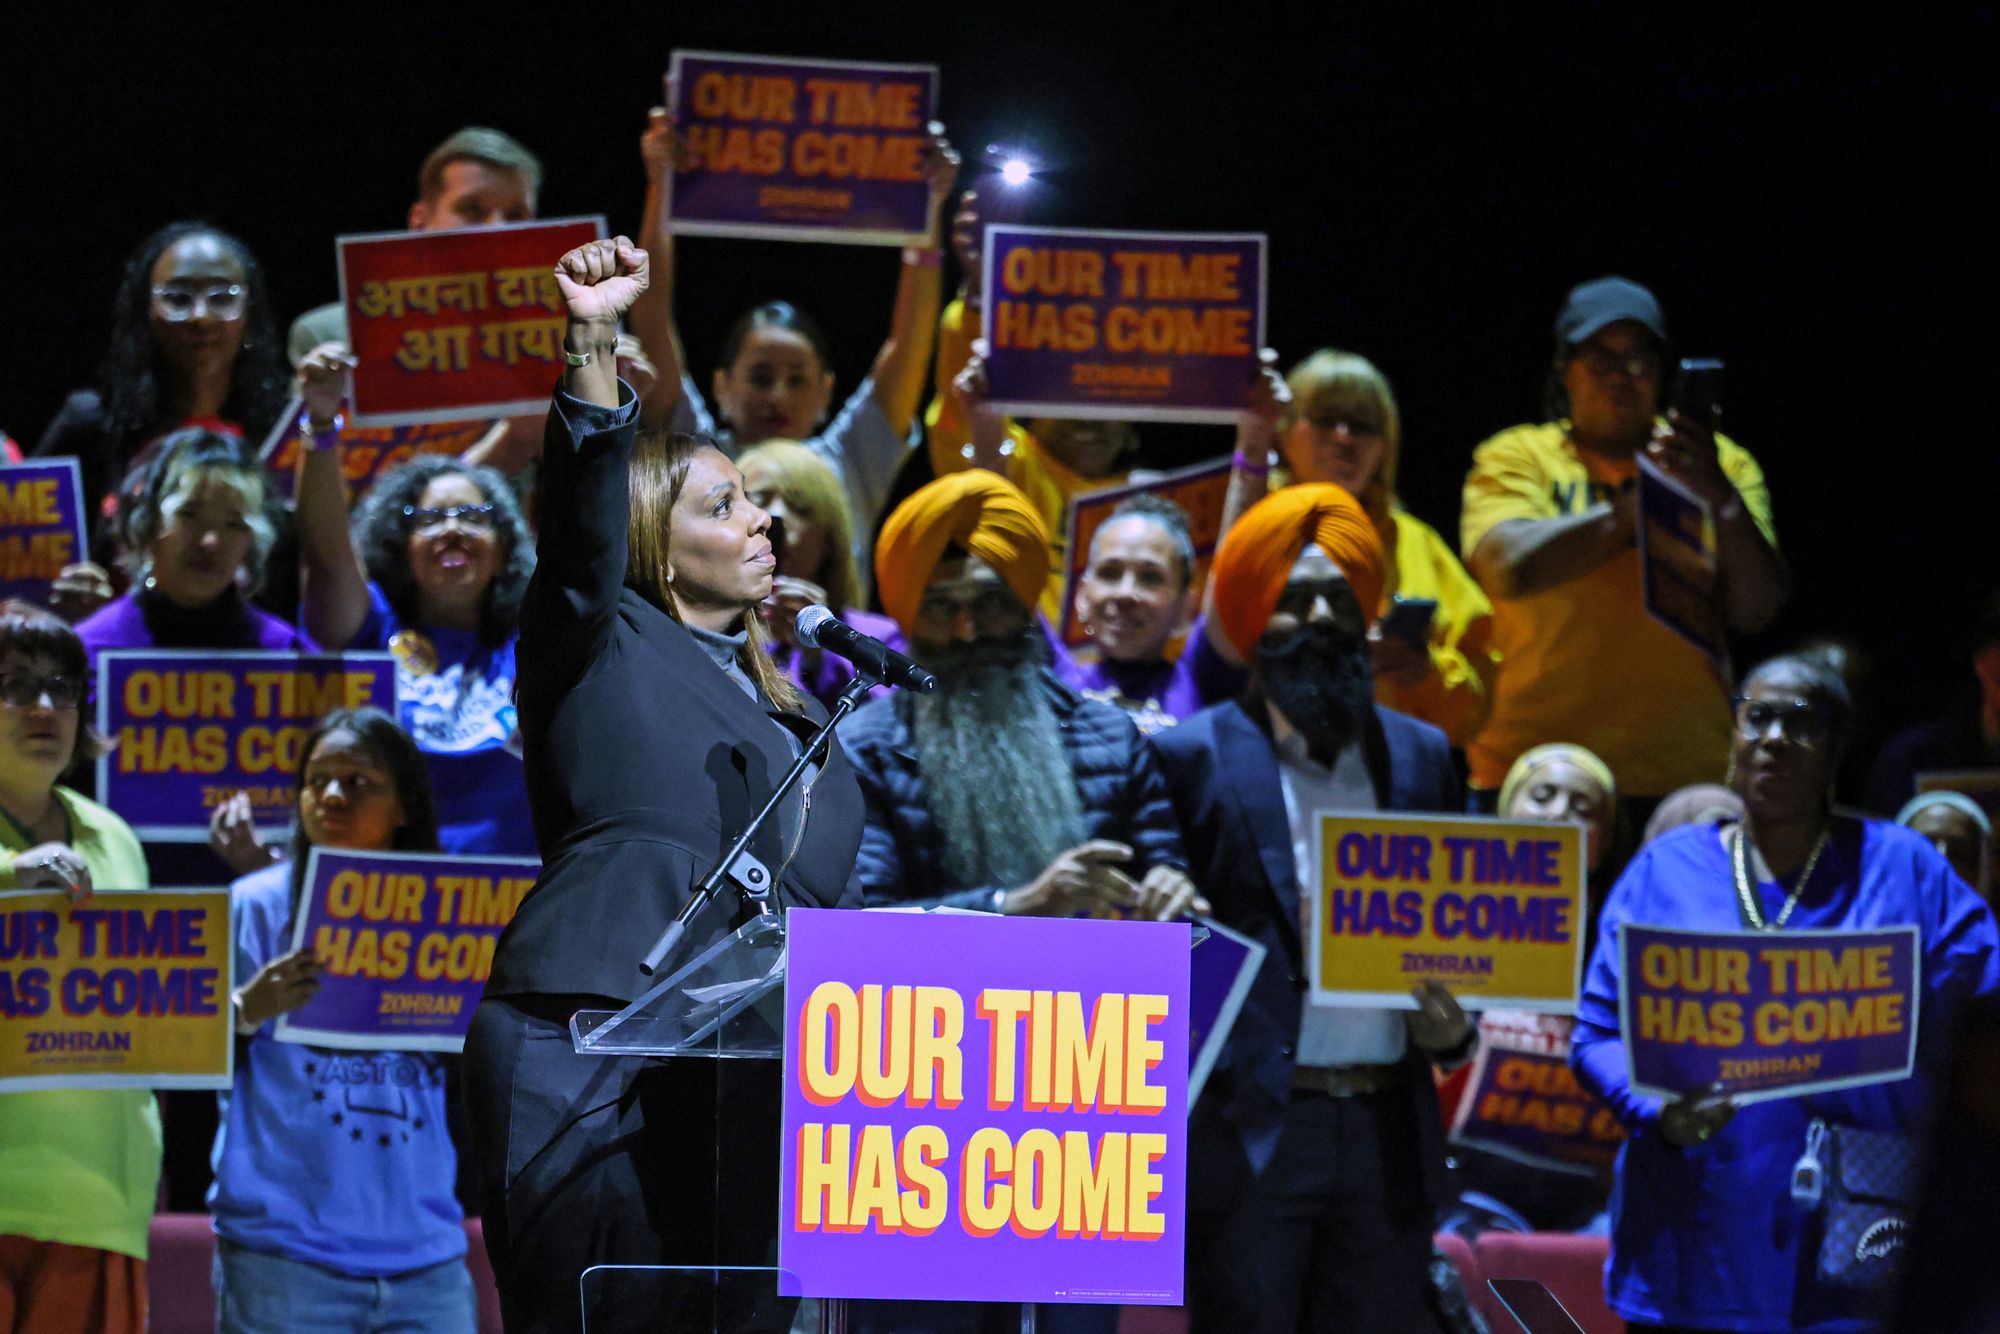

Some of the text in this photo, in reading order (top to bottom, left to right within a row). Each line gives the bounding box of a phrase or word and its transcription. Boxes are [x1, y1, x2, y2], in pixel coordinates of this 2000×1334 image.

[692, 71, 922, 128] OUR TIME
[688, 124, 928, 181] HAS COME
[357, 266, 562, 317] अपना टाइ
[1003, 246, 1241, 300] OUR TIME
[398, 326, 472, 371] आ
[995, 301, 1251, 356] HAS COME
[0, 479, 62, 527] ME
[0, 531, 73, 581] ME
[124, 670, 376, 720] OUR TIME
[118, 725, 303, 774] HAS CO
[1337, 832, 1561, 887] OUR TIME
[327, 868, 426, 923] OUR
[1330, 888, 1571, 945] HAS COME
[0, 909, 207, 960] UR TIME
[314, 925, 411, 980] HAS
[62, 967, 219, 1018] COME
[1640, 944, 1893, 996] OUR TIME
[378, 992, 462, 1016] ZOHRAN
[1638, 993, 1904, 1048] HAS COME
[26, 1031, 131, 1053] ZOHRAN
[798, 981, 1169, 1116] OUR TIME
[1719, 1053, 1822, 1080] ZOHRAN
[795, 1122, 1167, 1242] HAS COME
